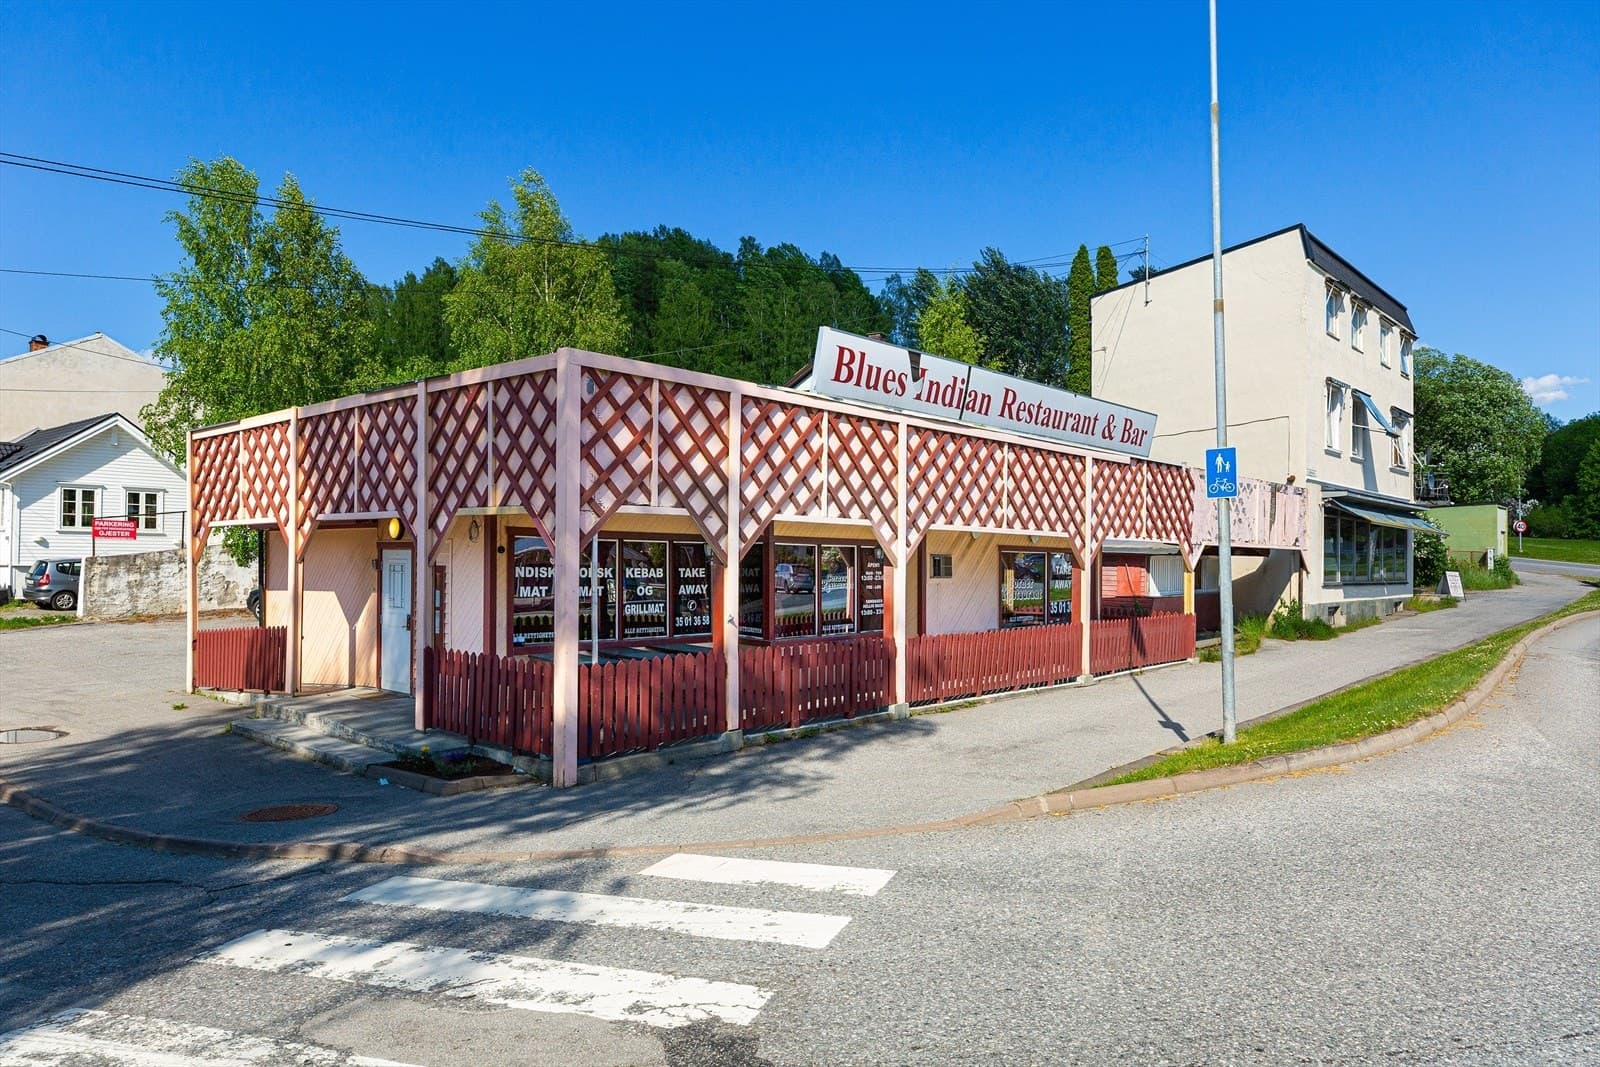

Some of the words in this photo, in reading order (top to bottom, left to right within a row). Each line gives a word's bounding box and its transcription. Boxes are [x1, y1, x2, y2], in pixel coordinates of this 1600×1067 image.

[830, 345, 908, 397] Blues
[913, 367, 992, 416] Indian
[998, 387, 1100, 436] Restaurant
[1102, 414, 1117, 440] &
[1120, 418, 1149, 447] Bar
[625, 567, 664, 578] KEBAB
[678, 567, 706, 578] TAKE
[519, 586, 548, 597] MAT
[637, 586, 653, 596] OG
[678, 584, 708, 595] AWAY
[624, 603, 665, 615] GRILLMAT
[1050, 602, 1058, 614] 35
[1058, 601, 1066, 613] 01
[675, 617, 684, 627] 35
[684, 616, 692, 626] 01
